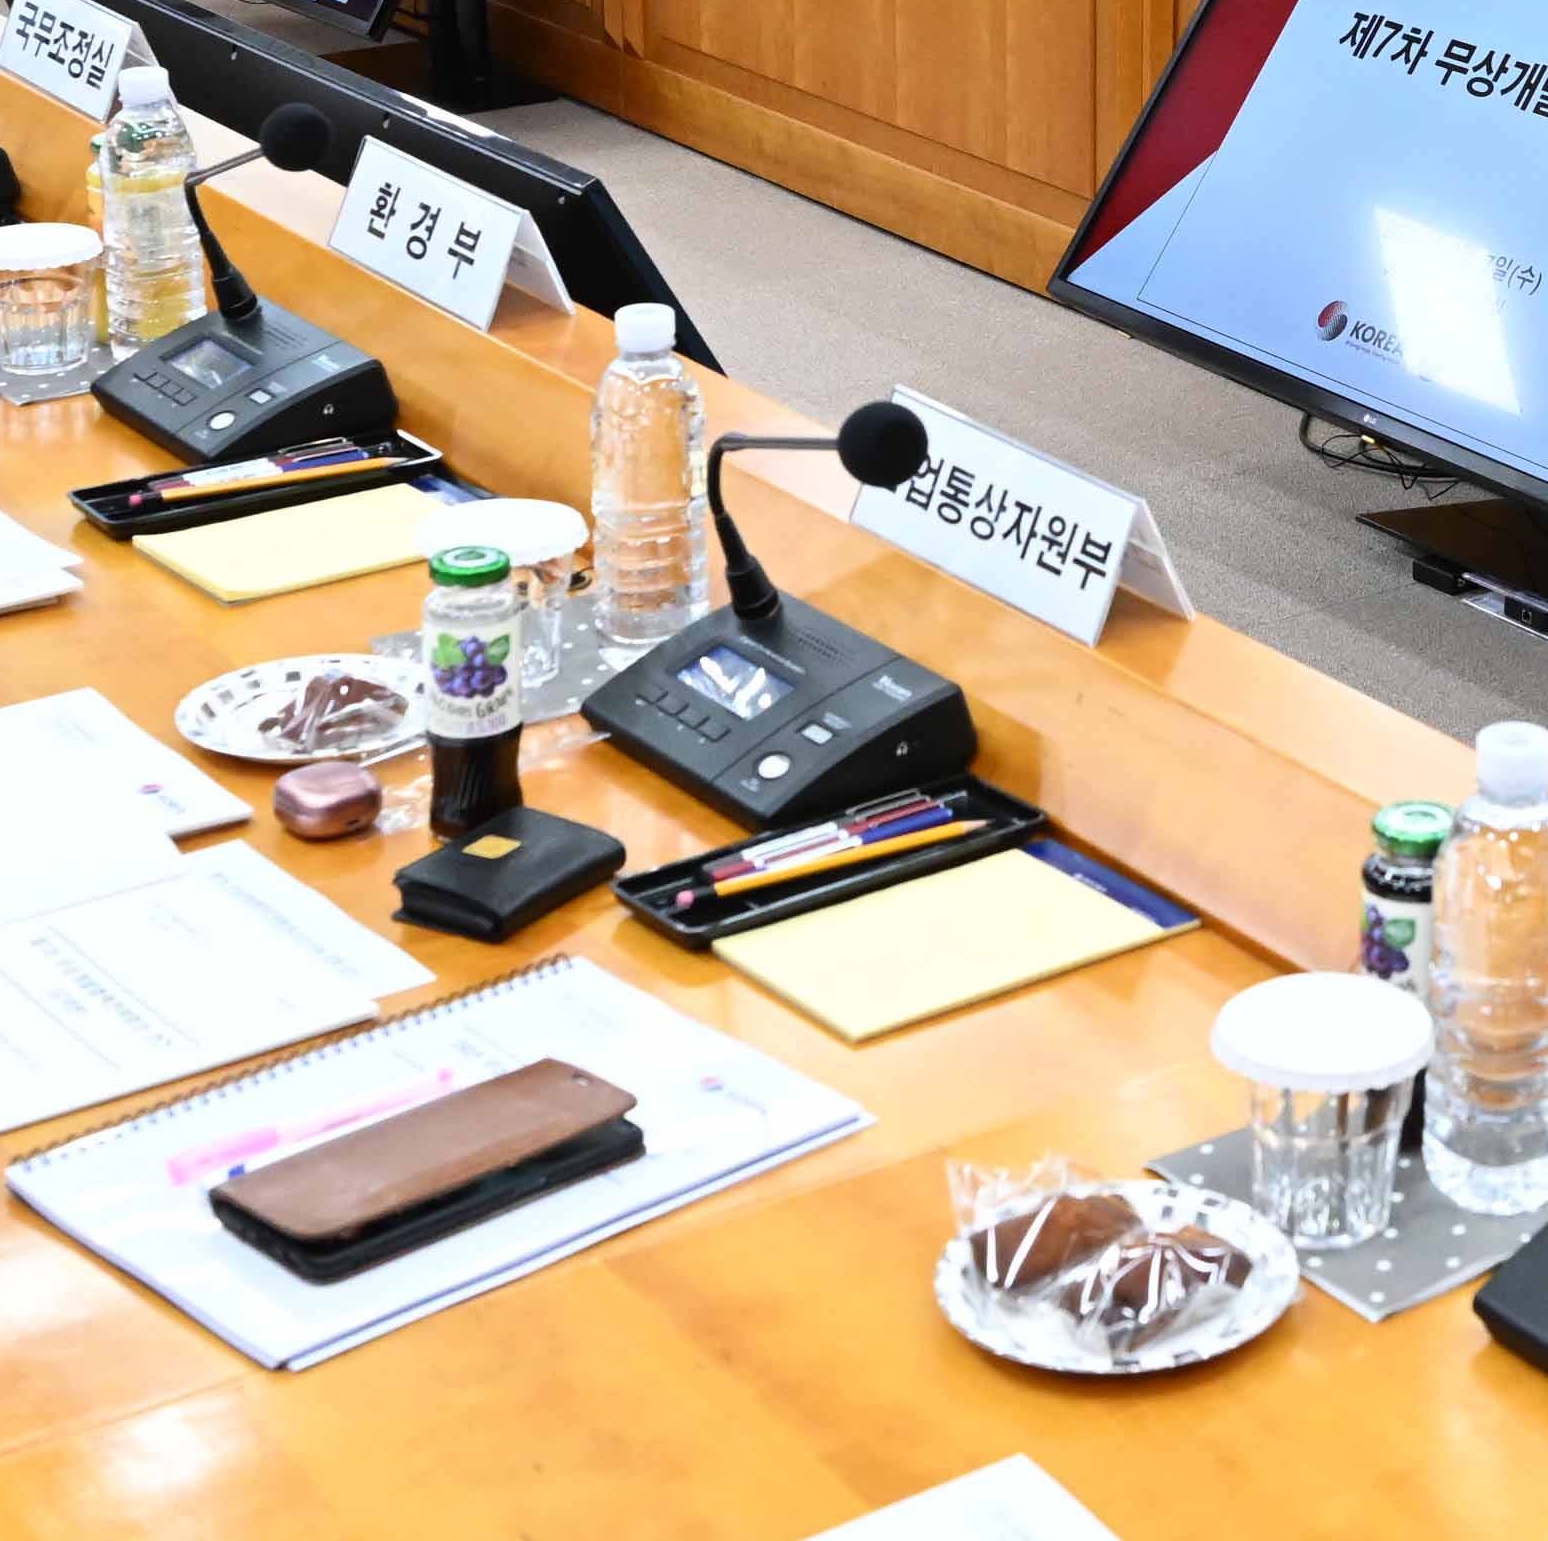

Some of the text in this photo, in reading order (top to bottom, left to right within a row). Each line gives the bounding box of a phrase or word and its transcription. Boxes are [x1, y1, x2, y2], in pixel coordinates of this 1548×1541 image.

[16, 1, 115, 90] 국무조정실
[1339, 11, 1435, 75] 제7차
[1349, 320, 1403, 356] KOREA
[886, 458, 1113, 590] 업통상자원부
